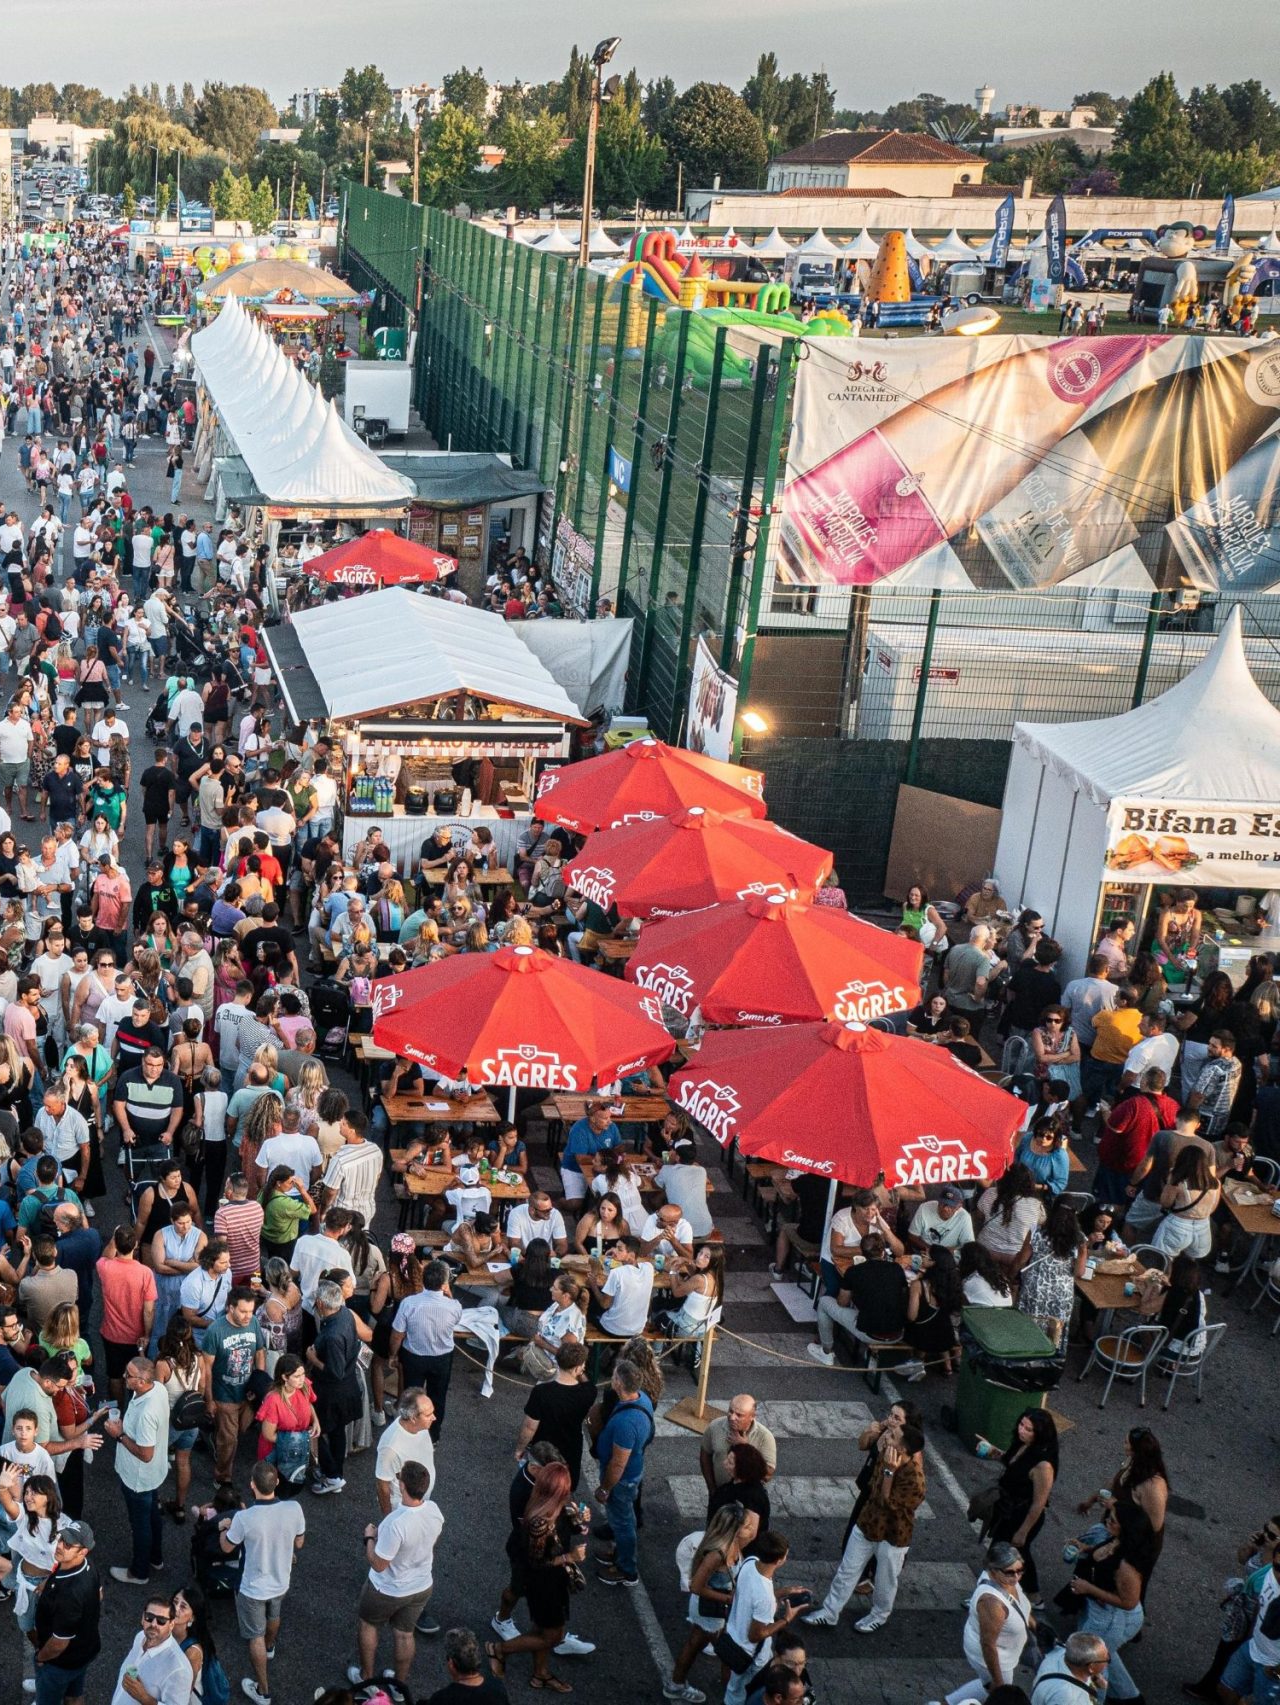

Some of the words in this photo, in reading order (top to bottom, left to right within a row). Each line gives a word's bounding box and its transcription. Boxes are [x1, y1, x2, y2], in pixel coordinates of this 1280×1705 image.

[388, 348, 401, 358] CA
[827, 393, 900, 402] CANTANHEDE
[836, 489, 878, 550] MARQUÉS
[1046, 510, 1069, 534] DE
[1230, 494, 1271, 556] MARQUÉS
[823, 509, 864, 568] MARIALVA
[1218, 519, 1256, 576] MARIALVA
[334, 570, 376, 584] SAGRES
[1121, 808, 1237, 836] Bifana
[1206, 852, 1214, 860] a
[1219, 851, 1269, 862] melhor
[570, 869, 614, 911] SAGRES
[636, 965, 694, 1015] SAGRES
[834, 986, 908, 1022] SAGRES
[736, 1010, 763, 1022] Somos
[764, 1012, 784, 1025] nós
[481, 1058, 578, 1092] SAGRES
[674, 1080, 736, 1144] SAGRES
[781, 1150, 814, 1170] Somos
[814, 1158, 836, 1174] nós
[894, 1150, 988, 1188] SAGRES
